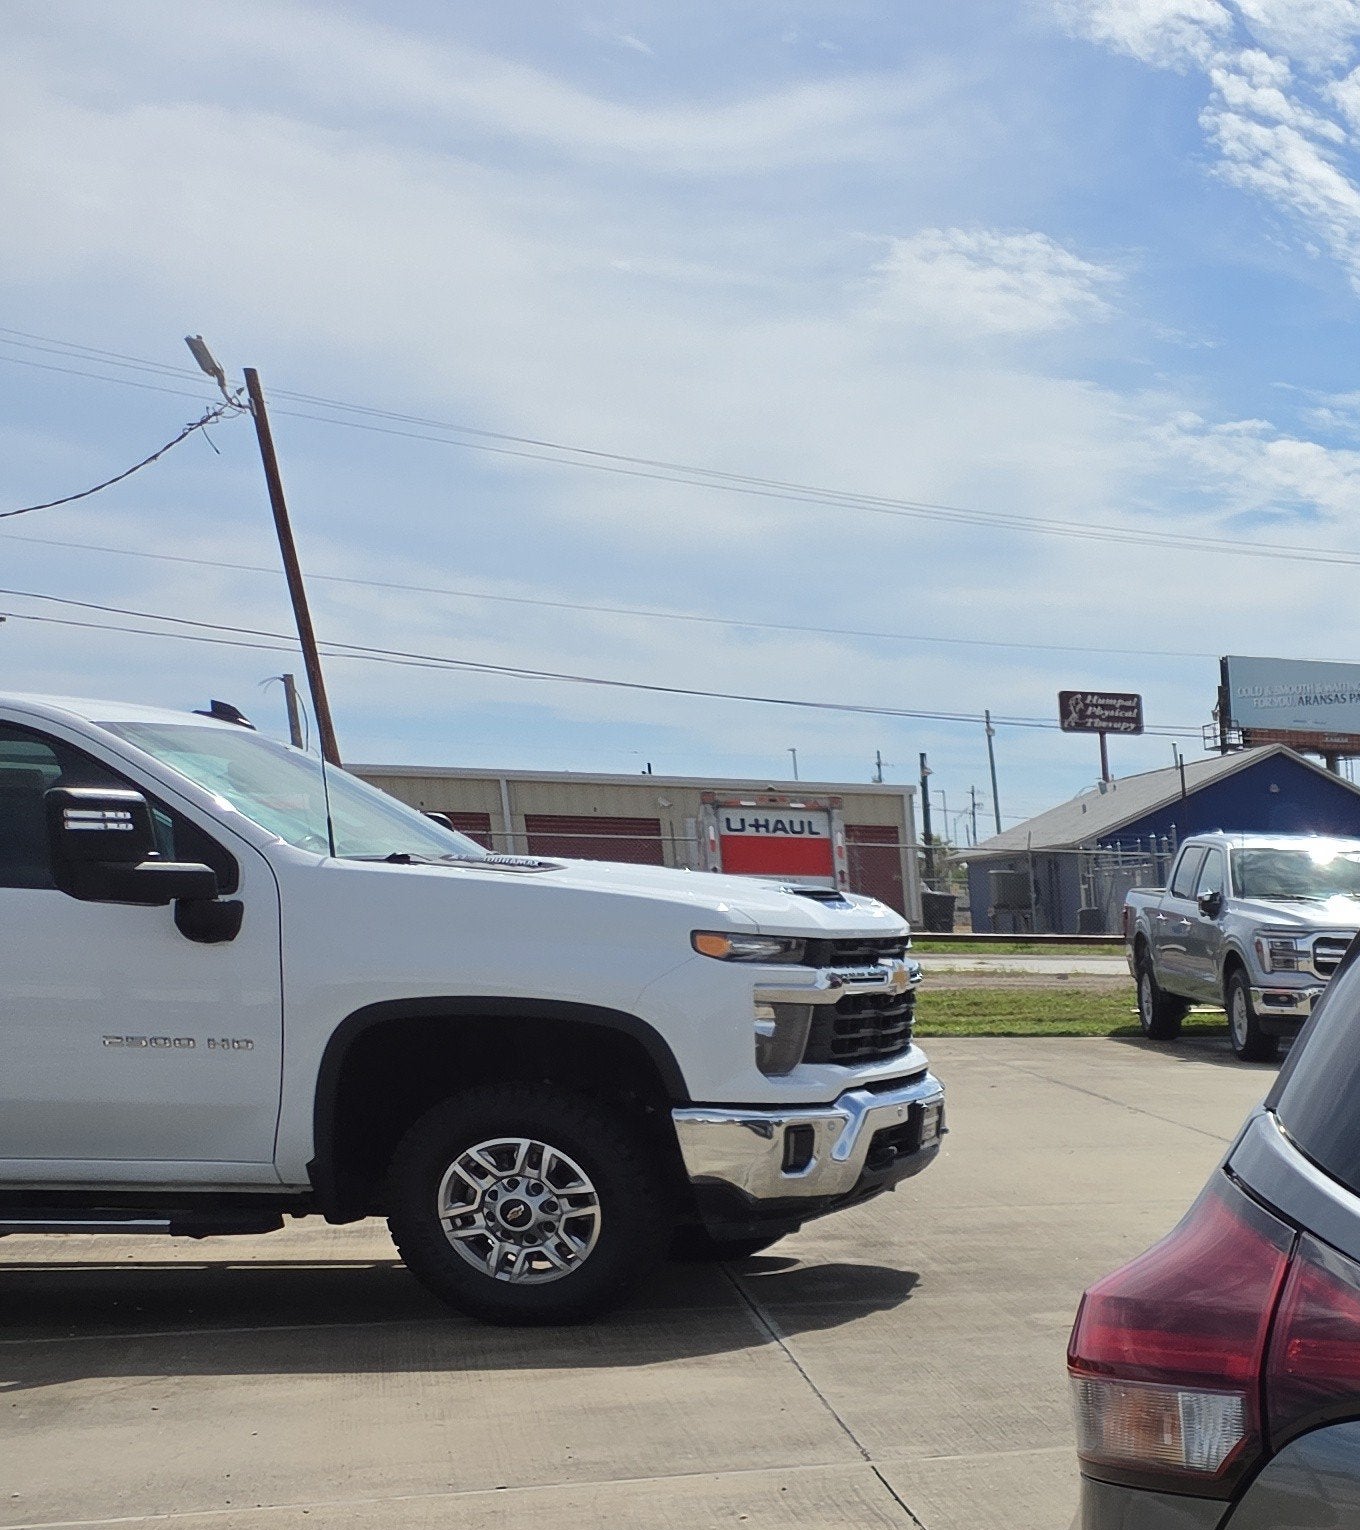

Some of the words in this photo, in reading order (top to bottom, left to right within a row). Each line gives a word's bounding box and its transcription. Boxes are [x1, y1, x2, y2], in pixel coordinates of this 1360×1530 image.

[1085, 694, 1137, 708] Humpal
[1298, 692, 1346, 707] ARANSAS
[1085, 706, 1137, 718] Physical
[1085, 718, 1137, 731] Therapy
[102, 1035, 196, 1048] 2500
[207, 1037, 255, 1050] HD
